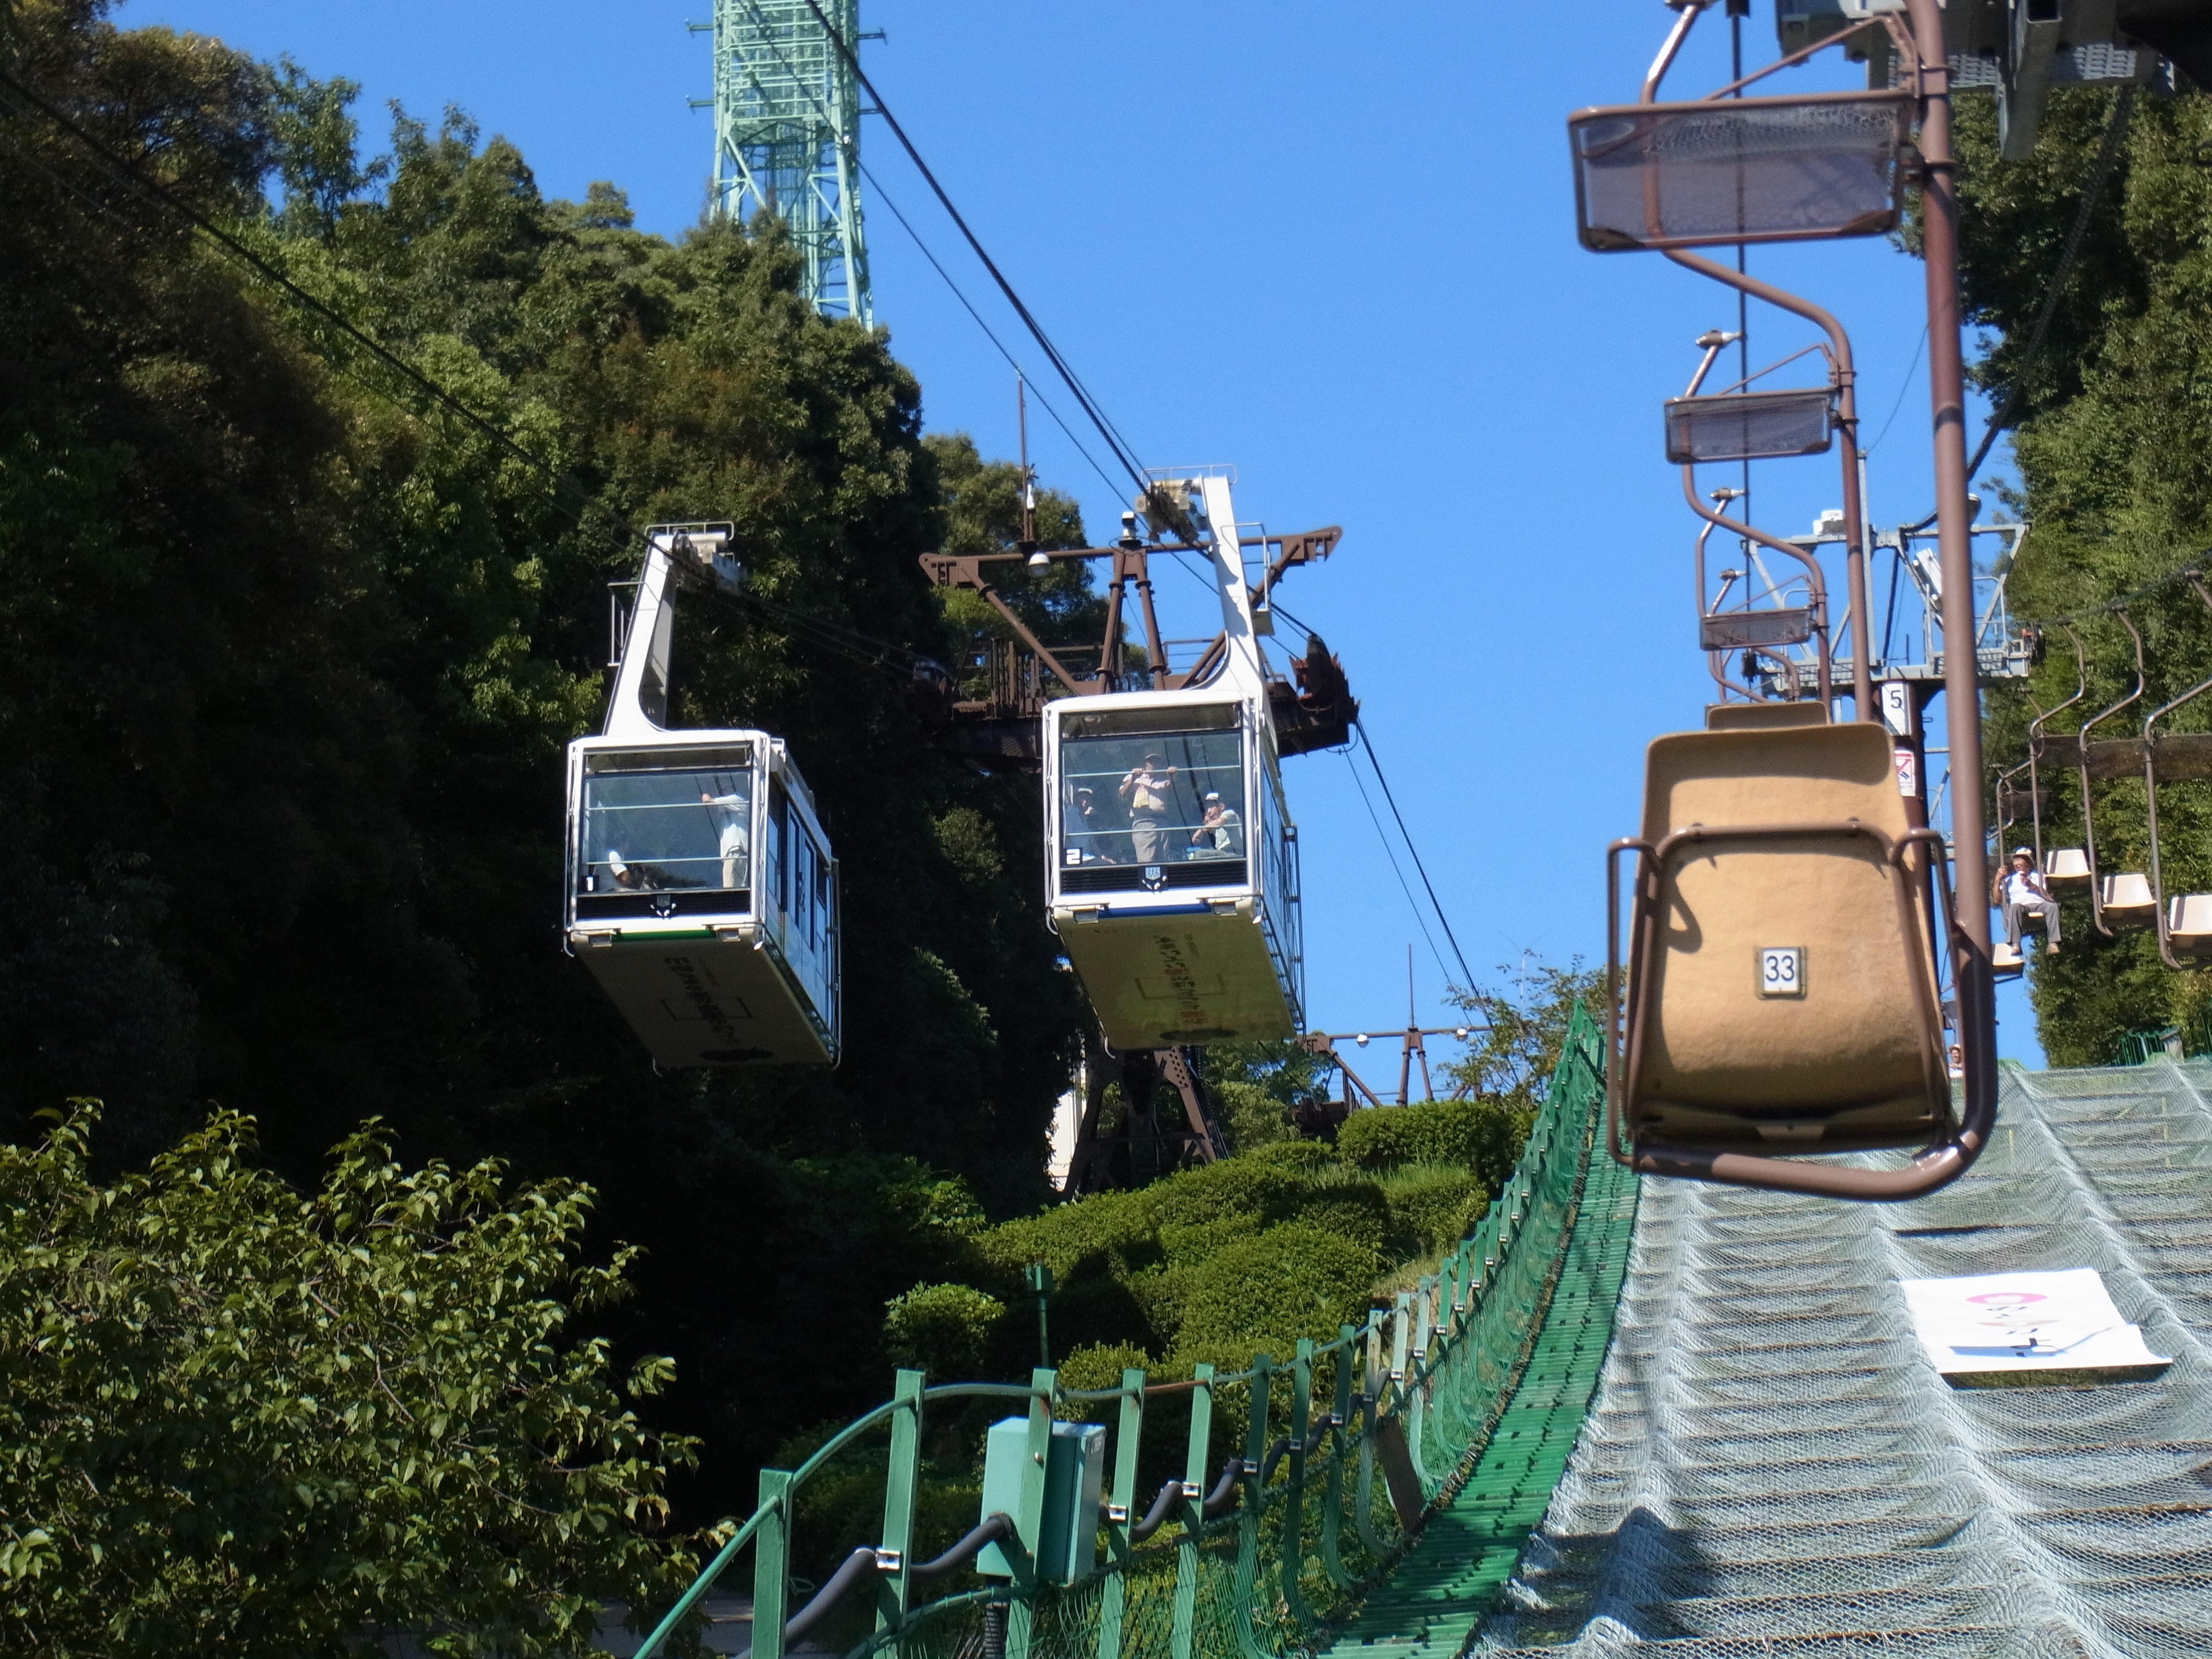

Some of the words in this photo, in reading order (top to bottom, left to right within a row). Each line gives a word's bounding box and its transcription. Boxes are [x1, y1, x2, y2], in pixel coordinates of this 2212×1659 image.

[1890, 689, 1903, 709] 5
[1067, 848, 1080, 865] 2
[1765, 954, 1795, 982] 33
